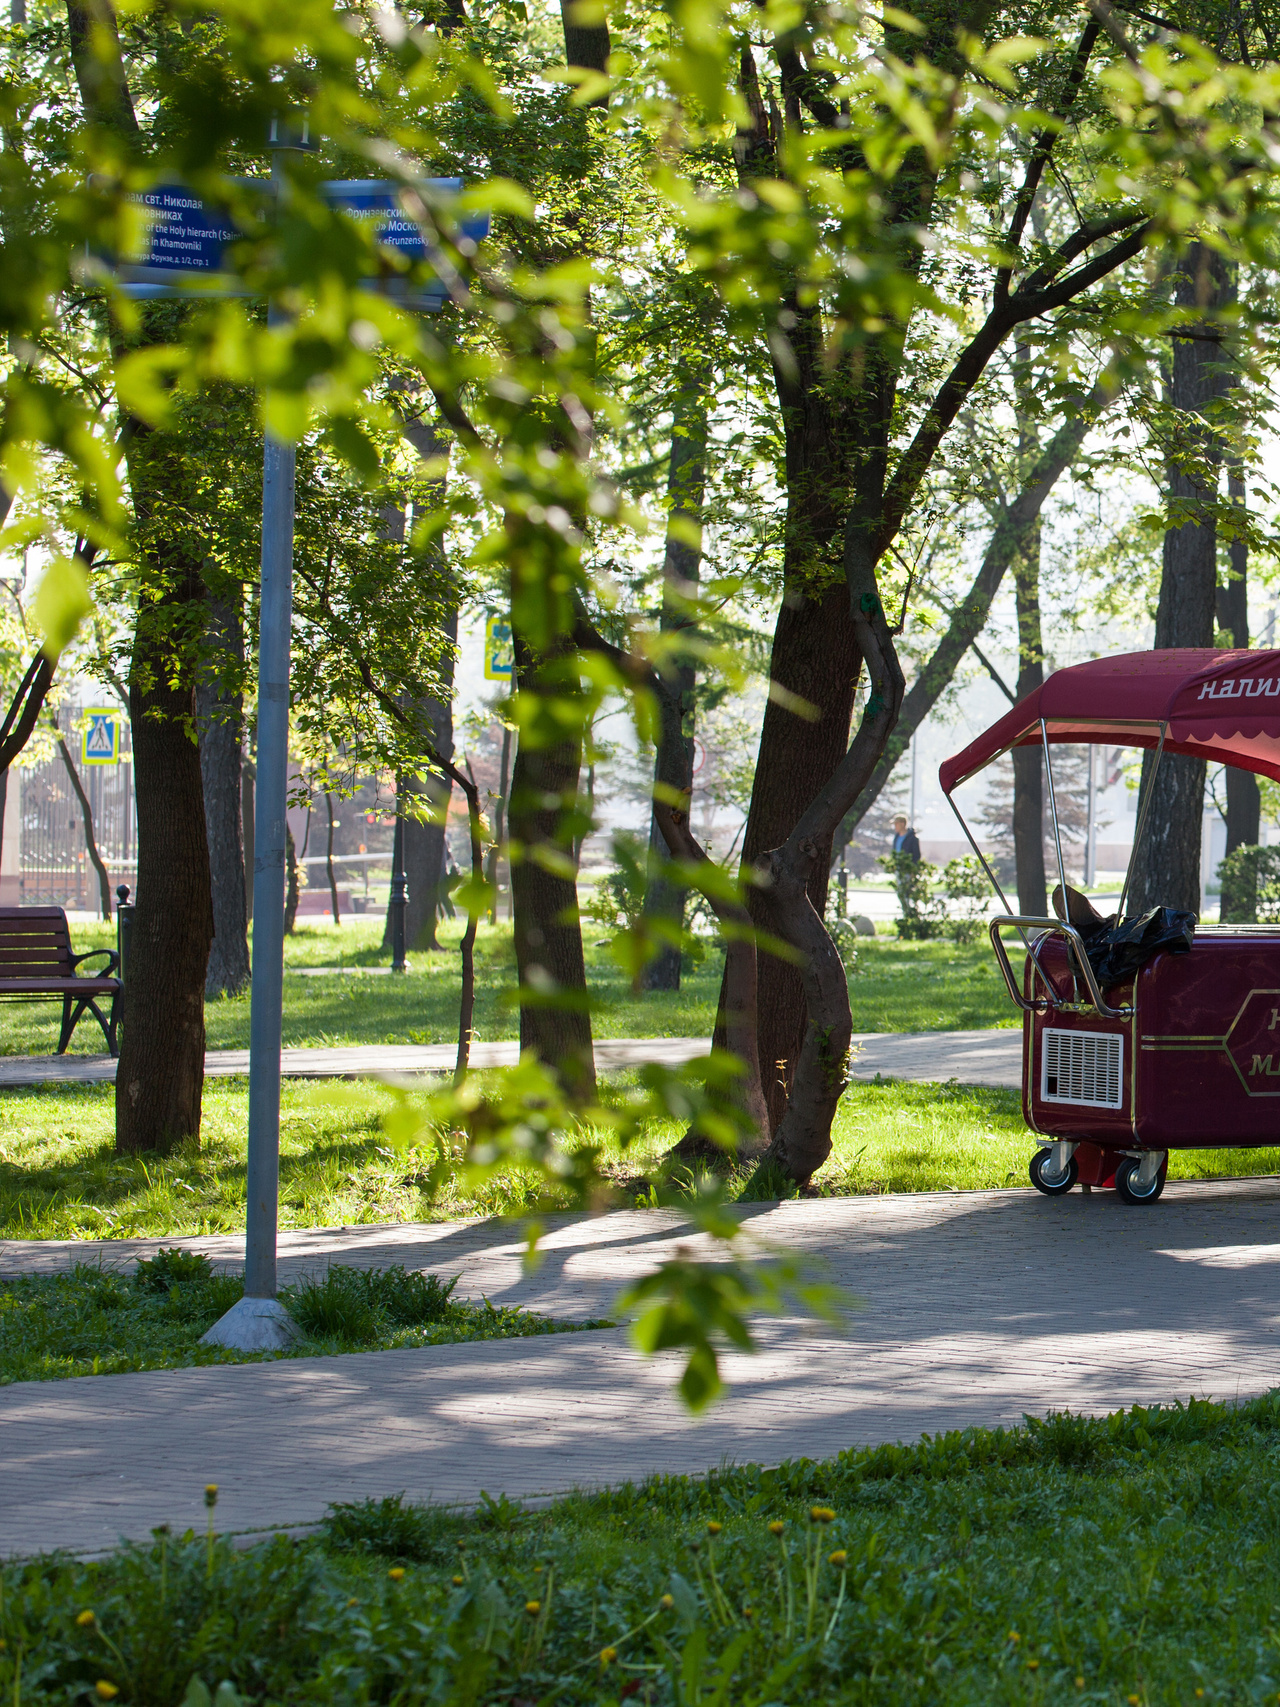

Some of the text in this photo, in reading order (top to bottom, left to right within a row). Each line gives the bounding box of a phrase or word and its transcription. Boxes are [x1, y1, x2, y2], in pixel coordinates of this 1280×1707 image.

[120, 191, 204, 210] рам свт. Николая
[132, 207, 184, 222] мовниках
[145, 223, 155, 232] of
[155, 223, 168, 234] the
[169, 225, 187, 239] Holy
[187, 227, 218, 240] hierarch
[151, 238, 159, 247] in
[160, 238, 202, 252] Khamovniki
[383, 235, 430, 247] «Frunzensky
